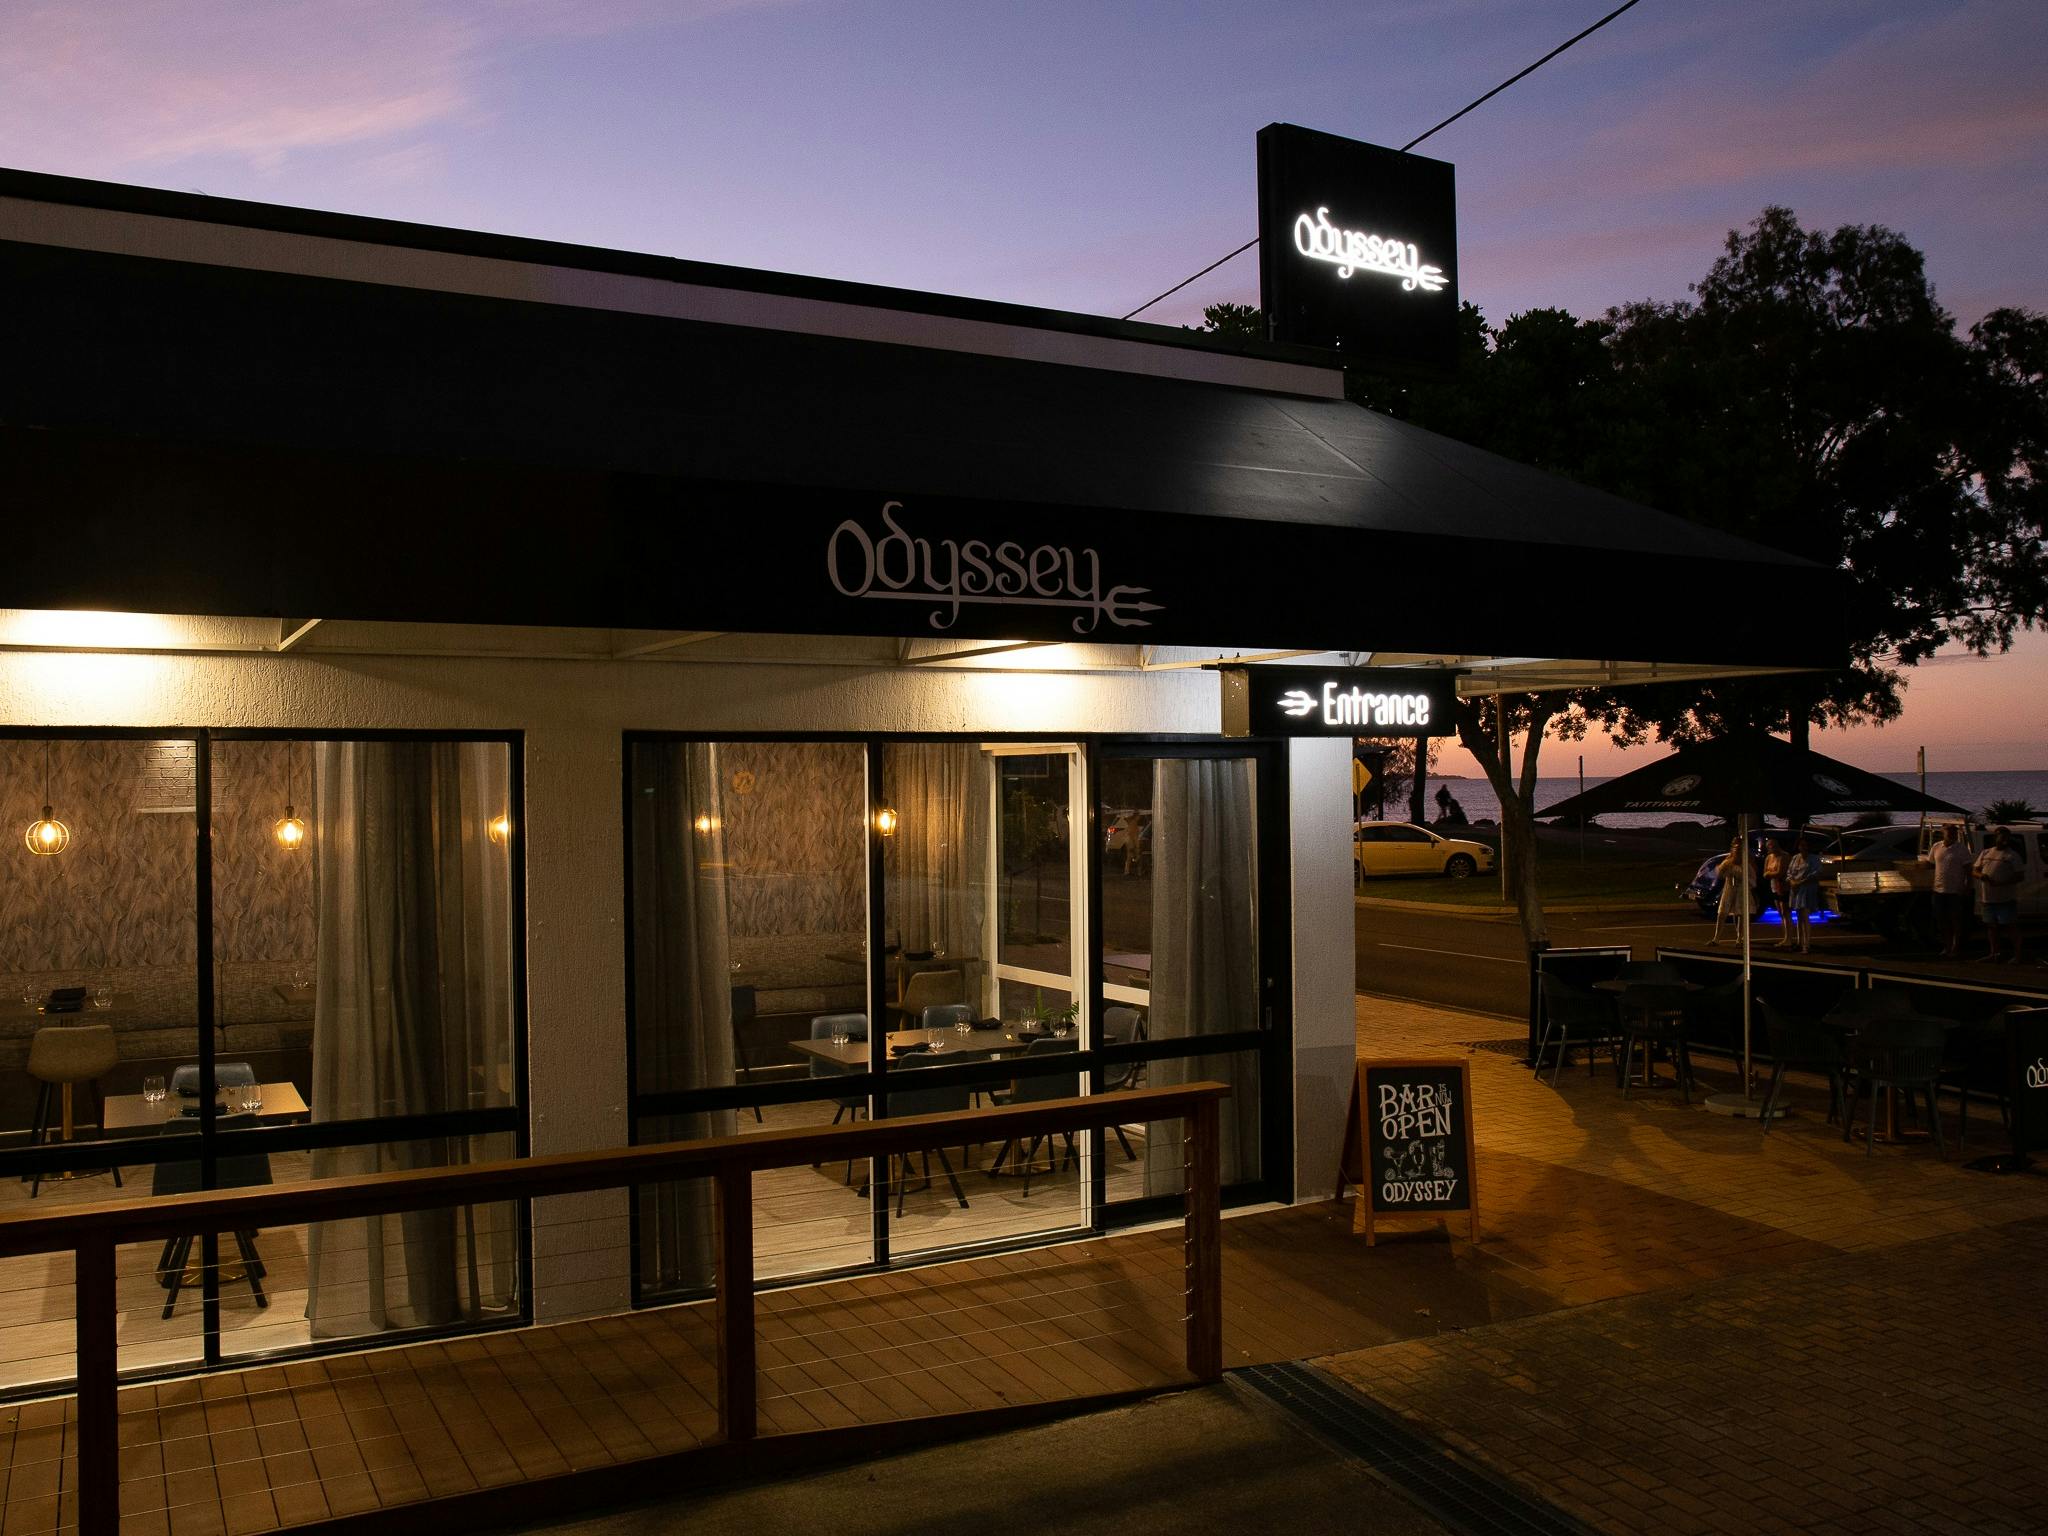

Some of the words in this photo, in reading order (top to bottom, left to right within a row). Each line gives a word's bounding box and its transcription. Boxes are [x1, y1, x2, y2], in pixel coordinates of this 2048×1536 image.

[1294, 207, 1419, 291] Odyssey
[827, 501, 1100, 634] Odyssey
[1323, 682, 1430, 726] Entrance
[1624, 800, 1701, 808] TAITTINGER
[1378, 1083, 1436, 1122] BAR
[1382, 1103, 1453, 1140] OPEN
[1382, 1179, 1458, 1203] ODYSSEY
